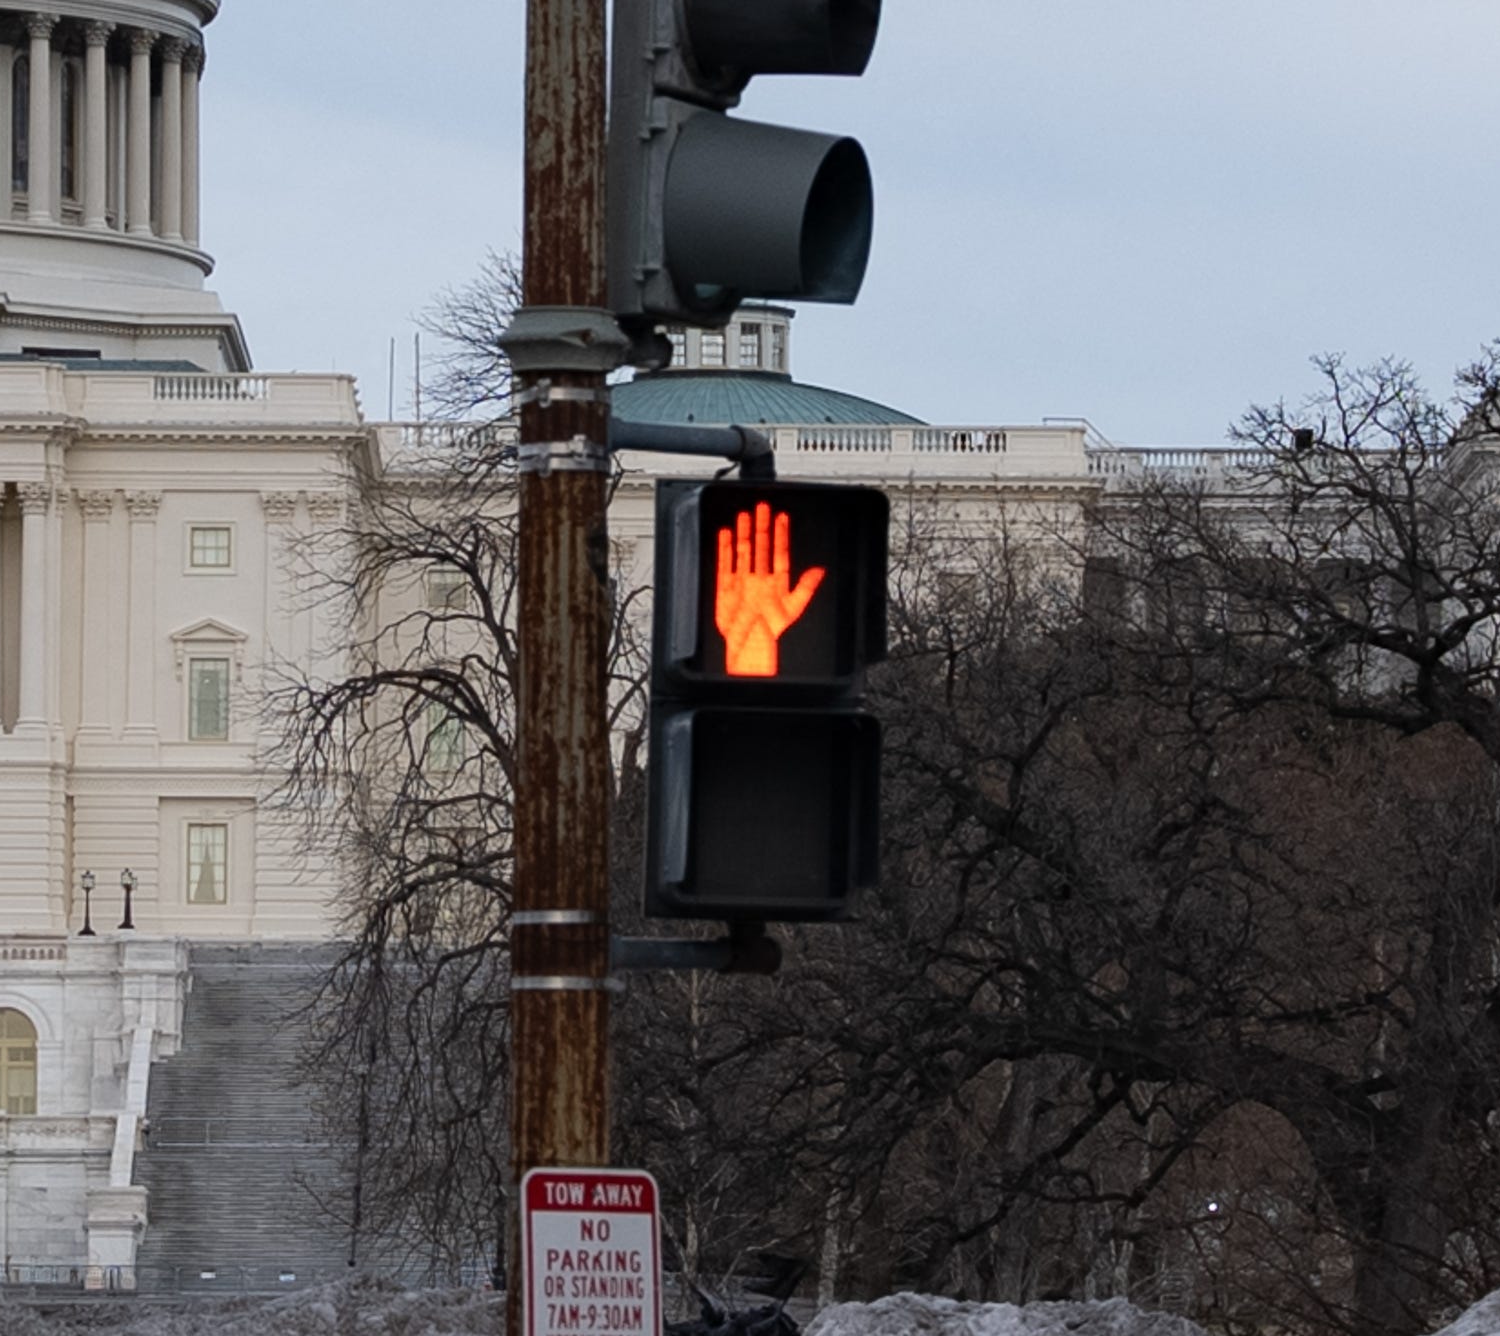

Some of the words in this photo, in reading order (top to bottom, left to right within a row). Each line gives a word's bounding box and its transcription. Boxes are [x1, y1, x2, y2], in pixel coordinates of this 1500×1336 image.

[544, 1182, 585, 1205] TOW
[593, 1183, 643, 1207] AWAY
[580, 1219, 611, 1242] NO
[547, 1249, 642, 1273] PARKING
[544, 1275, 566, 1298] OR
[571, 1276, 644, 1299] STANDING
